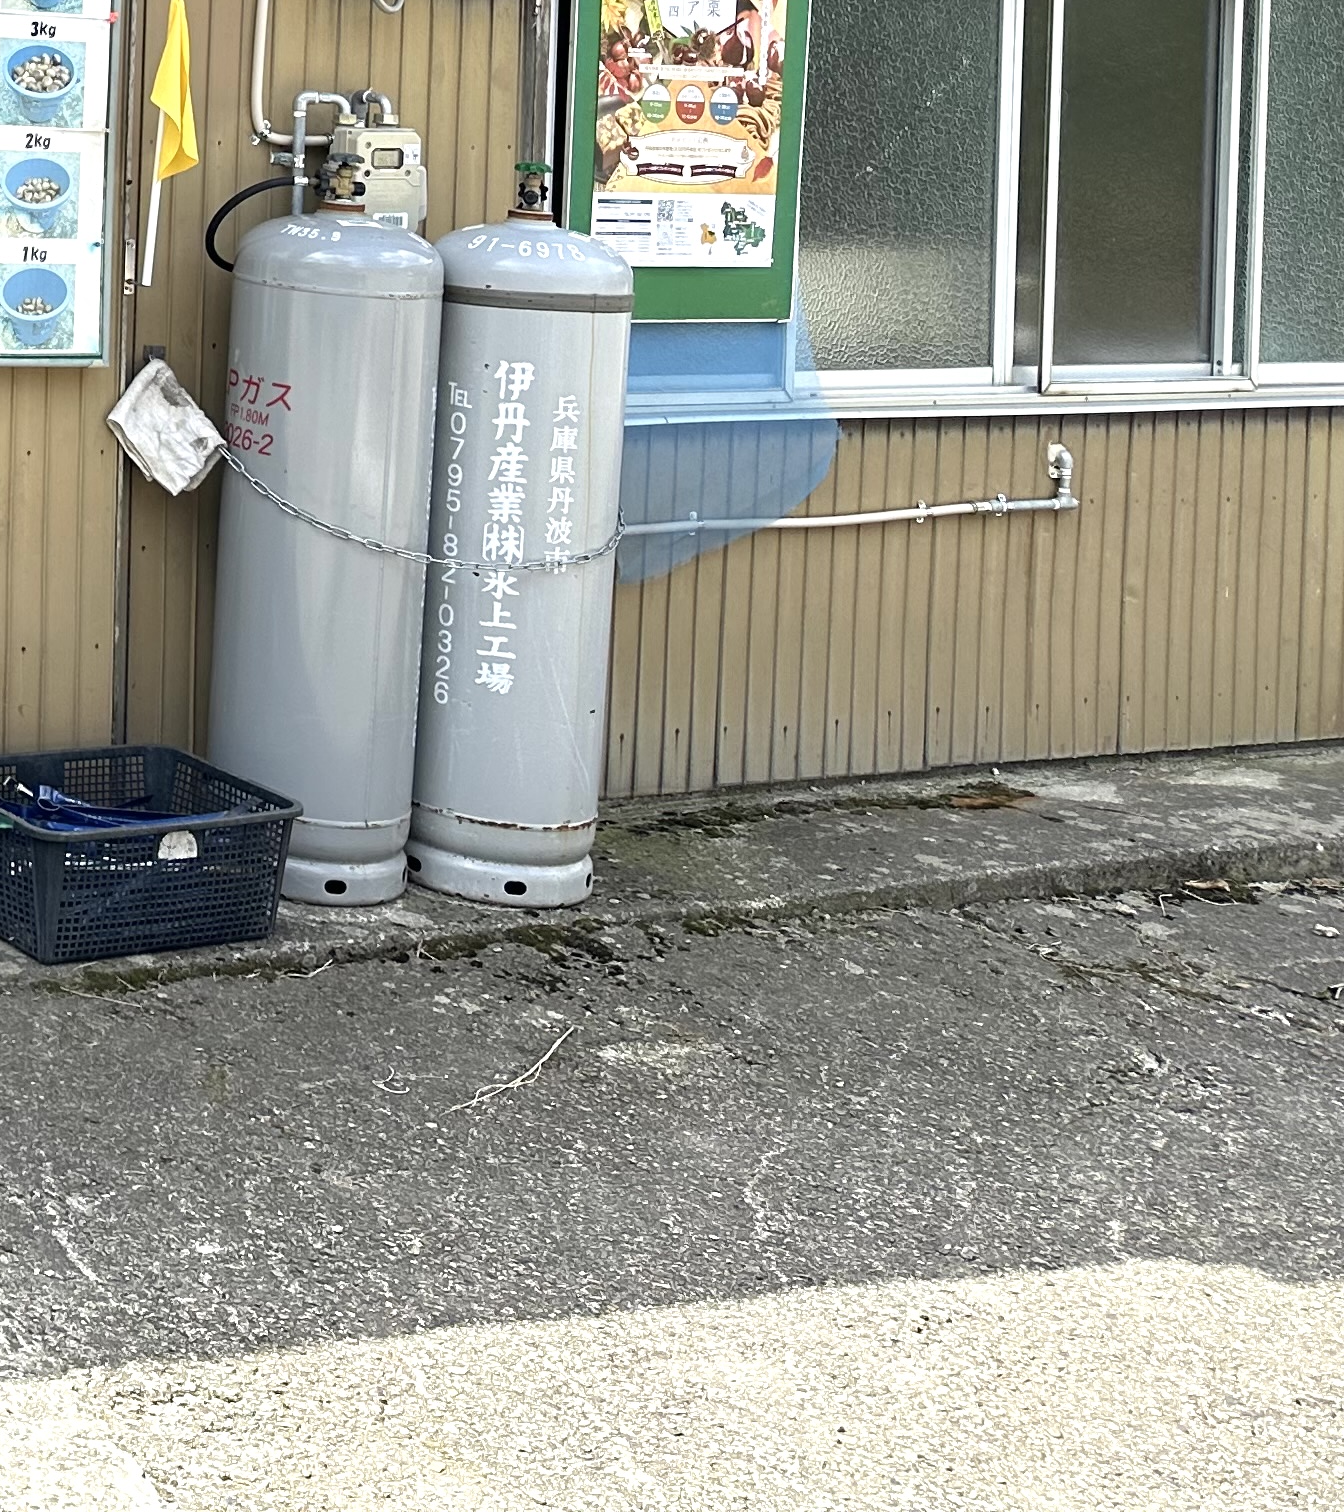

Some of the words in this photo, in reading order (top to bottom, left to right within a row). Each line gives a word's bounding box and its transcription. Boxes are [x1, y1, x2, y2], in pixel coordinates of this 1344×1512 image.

[31, 21, 56, 38] 3kg
[25, 133, 51, 150] 2kg
[23, 247, 47, 262] 1kg
[467, 234, 586, 262] 91-6978
[227, 368, 291, 411] Pガス
[225, 420, 274, 456] 026-2
[544, 394, 581, 574] 兵庫県丹波市
